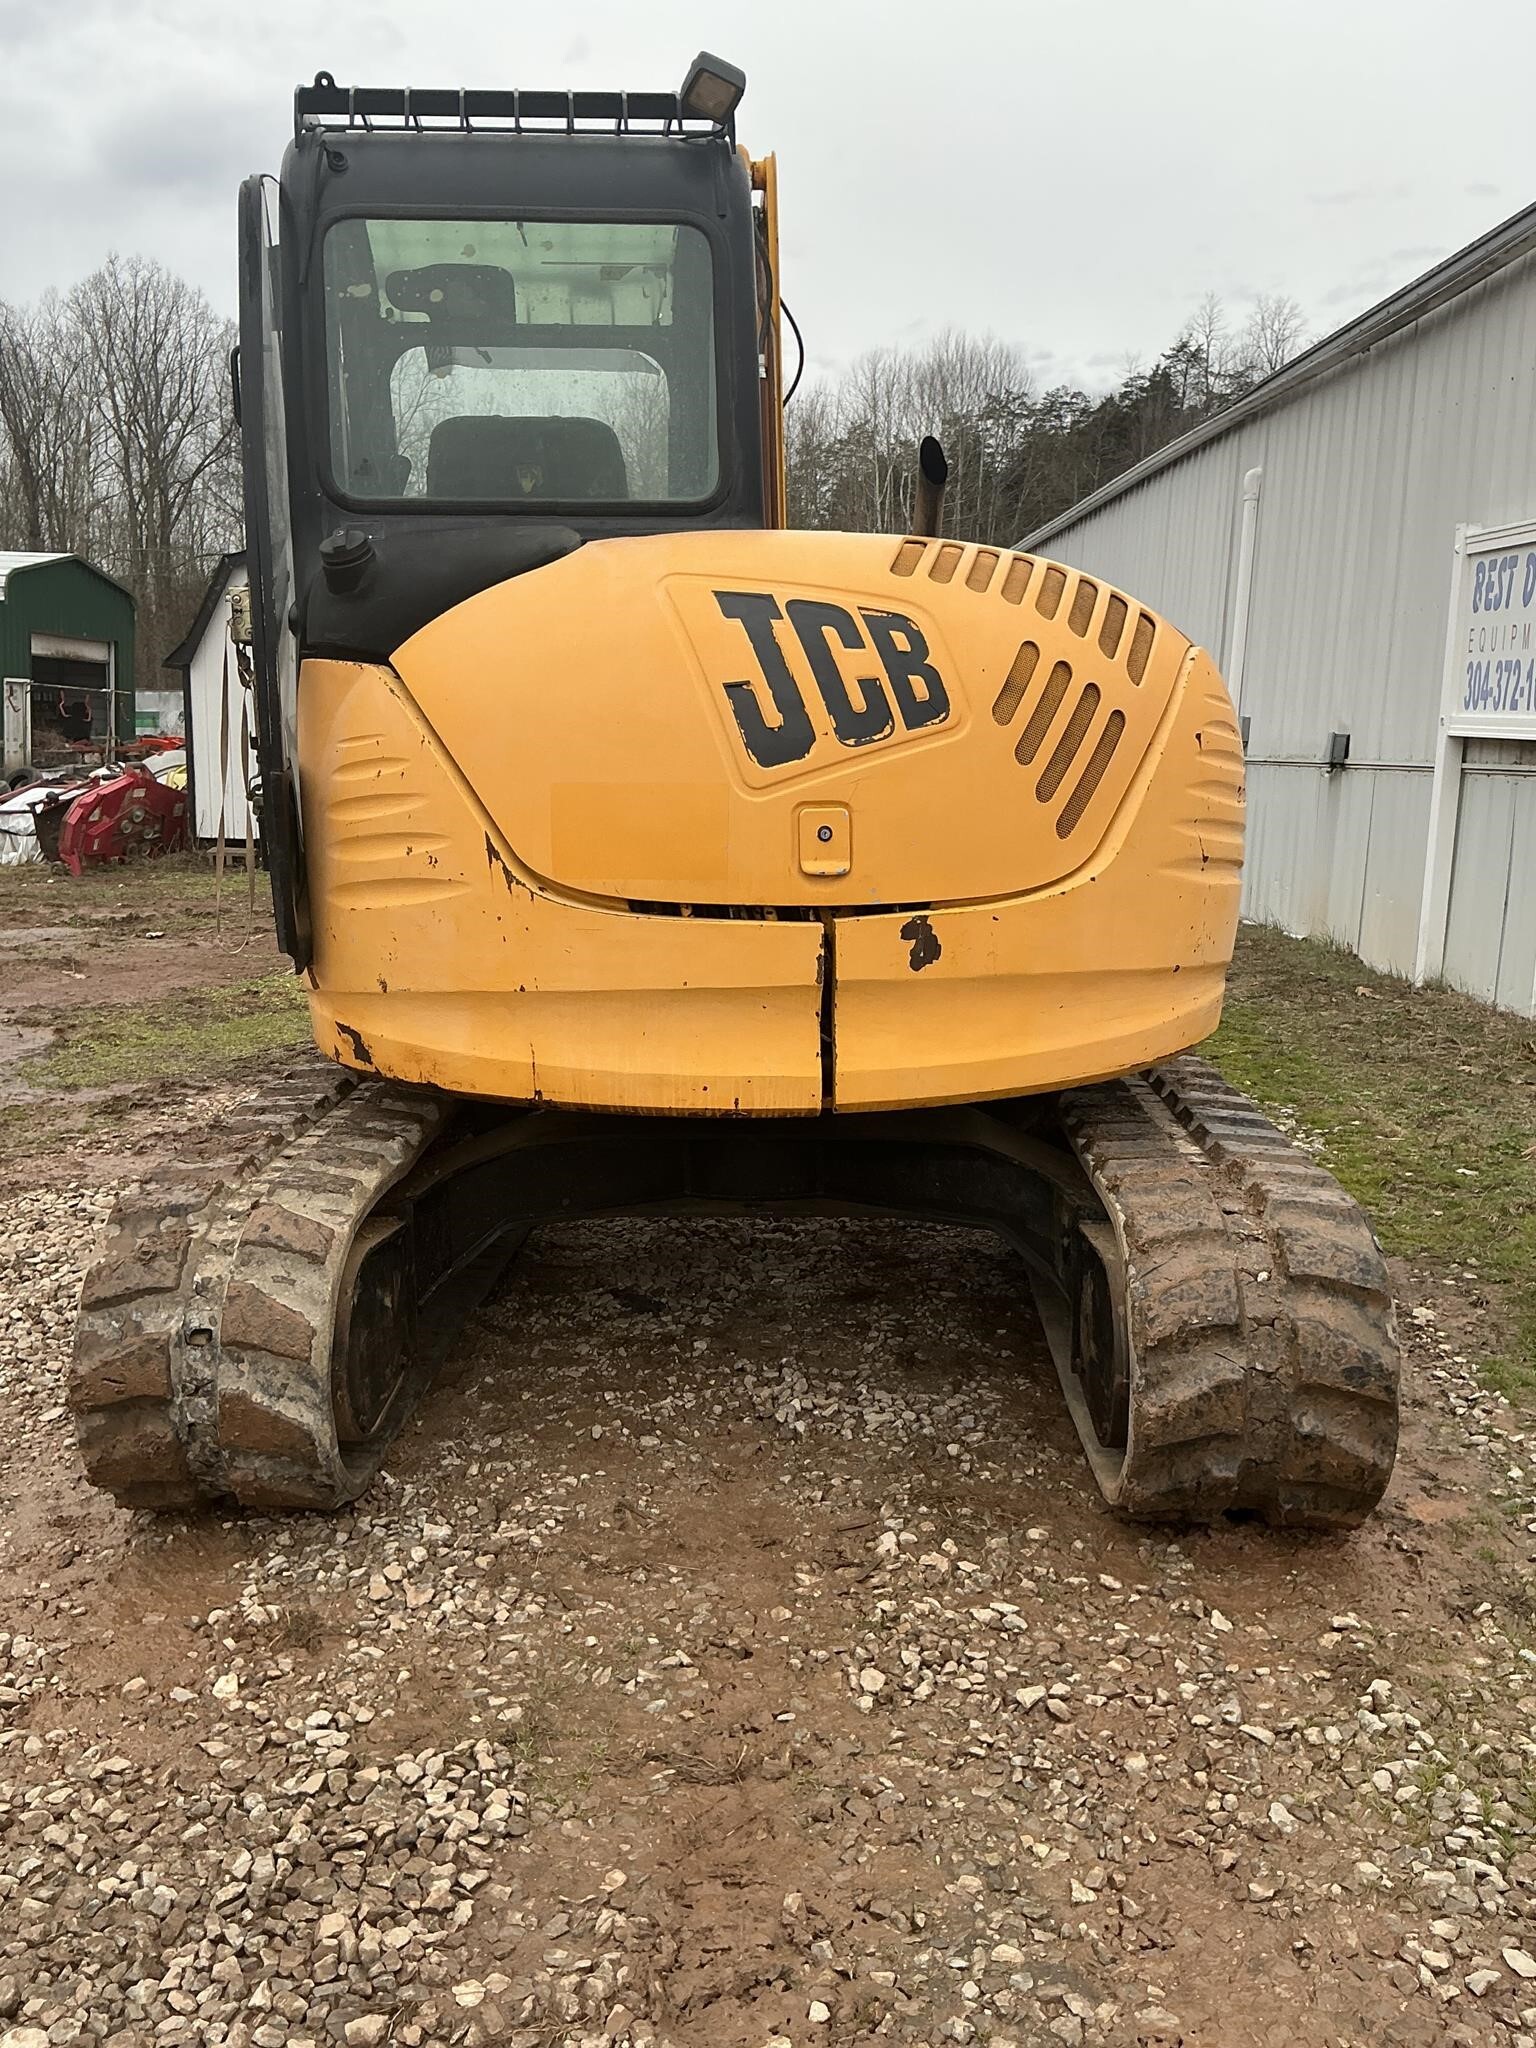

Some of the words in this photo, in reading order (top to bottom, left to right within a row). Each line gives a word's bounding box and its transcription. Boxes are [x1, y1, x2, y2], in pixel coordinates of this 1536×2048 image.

[1473, 555, 1519, 614] BEST
[1523, 552, 1536, 608] D
[711, 590, 951, 768] JCB
[1463, 658, 1536, 711] 304-372-1
